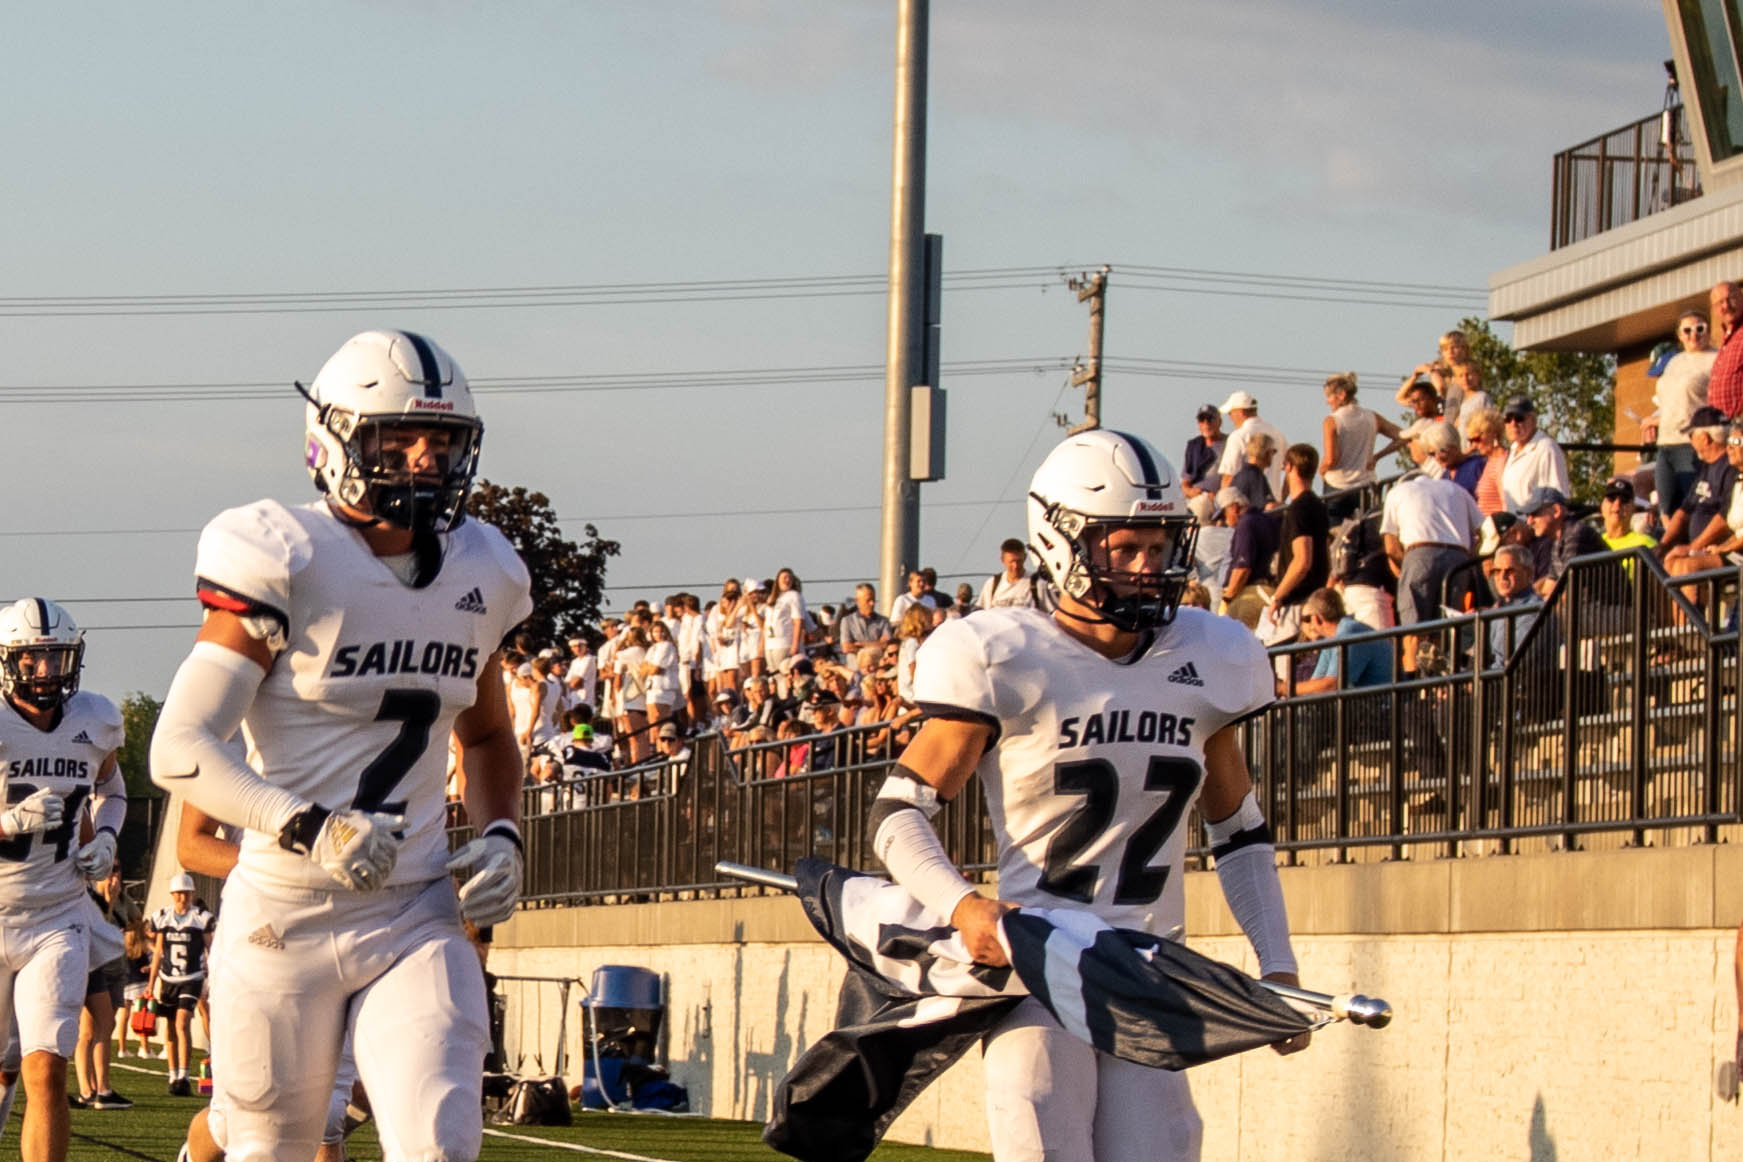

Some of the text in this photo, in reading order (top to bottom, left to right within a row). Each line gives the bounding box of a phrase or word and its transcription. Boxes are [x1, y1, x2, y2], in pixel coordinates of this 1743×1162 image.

[414, 399, 454, 411] Riddell
[1138, 502, 1174, 512] Riddell
[330, 639, 479, 679] SAILORS
[1167, 674, 1205, 688] adidas
[1058, 709, 1196, 749] SAILORS
[8, 757, 89, 779] SAILORS
[1036, 755, 1202, 906] 22
[170, 943, 188, 977] 5
